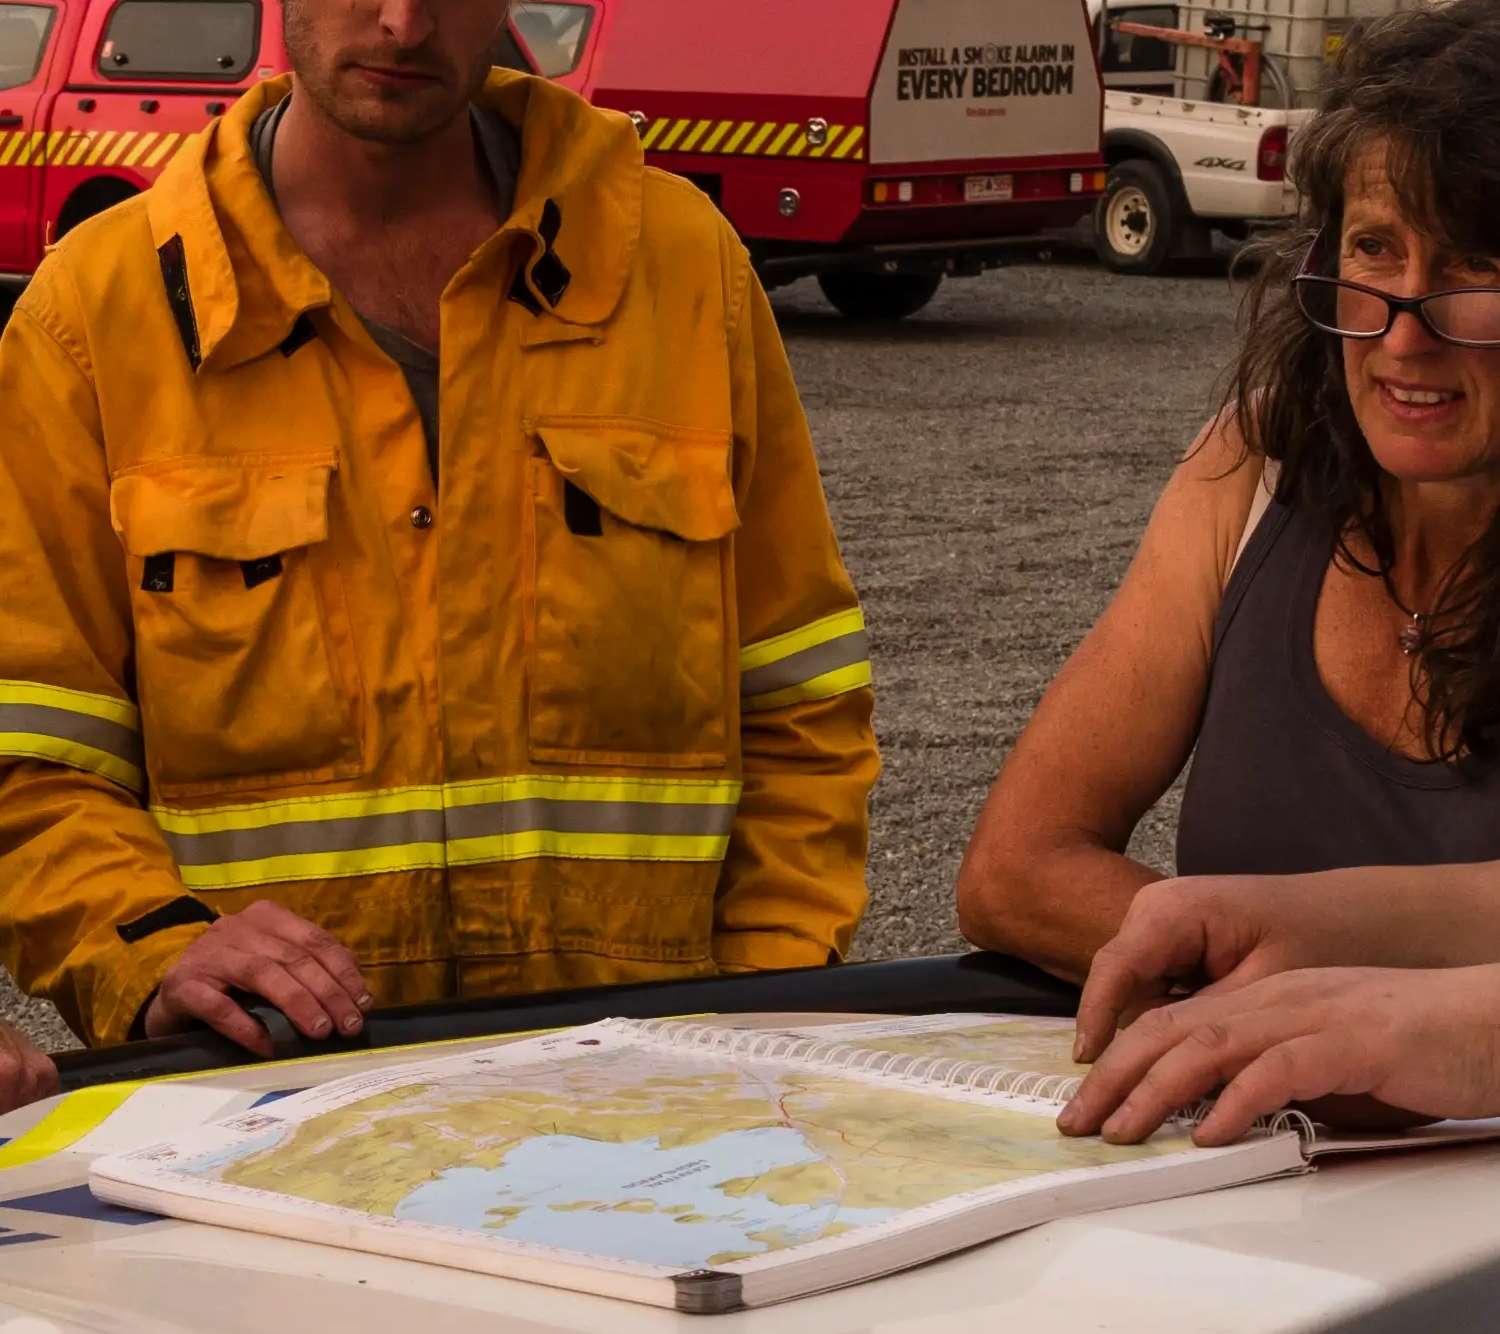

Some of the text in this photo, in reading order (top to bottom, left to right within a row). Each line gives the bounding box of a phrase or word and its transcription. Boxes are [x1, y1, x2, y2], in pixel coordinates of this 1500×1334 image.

[898, 44, 1075, 67] INSTALL A SMOKE ALARM IN
[897, 65, 1075, 101] EVERY BEDROOM
